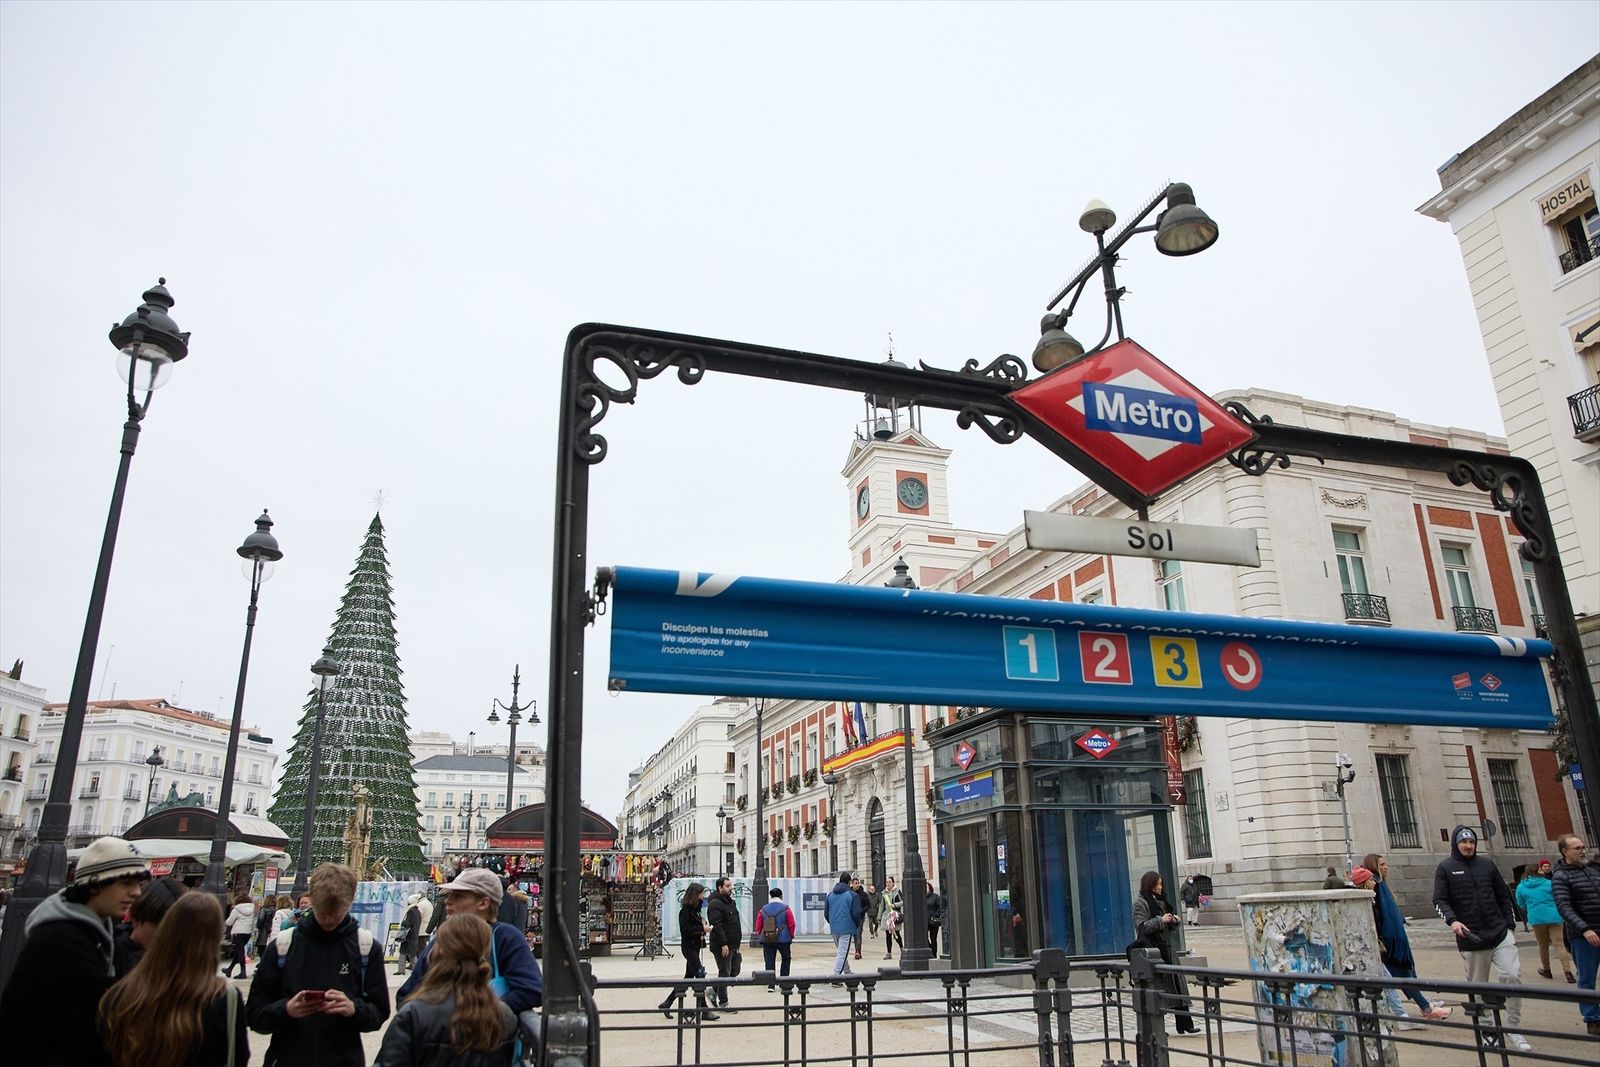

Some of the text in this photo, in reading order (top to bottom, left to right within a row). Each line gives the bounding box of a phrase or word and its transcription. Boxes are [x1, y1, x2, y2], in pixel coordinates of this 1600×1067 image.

[1541, 179, 1589, 216] HOSTAL
[1094, 389, 1193, 433] Metro
[1127, 525, 1174, 552] Sol
[662, 622, 769, 638] Disculpen las molestias
[661, 634, 750, 649] We apologize for any
[661, 645, 725, 657] inconvenience
[1018, 632, 1189, 682] 1 2 3
[1087, 739, 1107, 748] Metro
